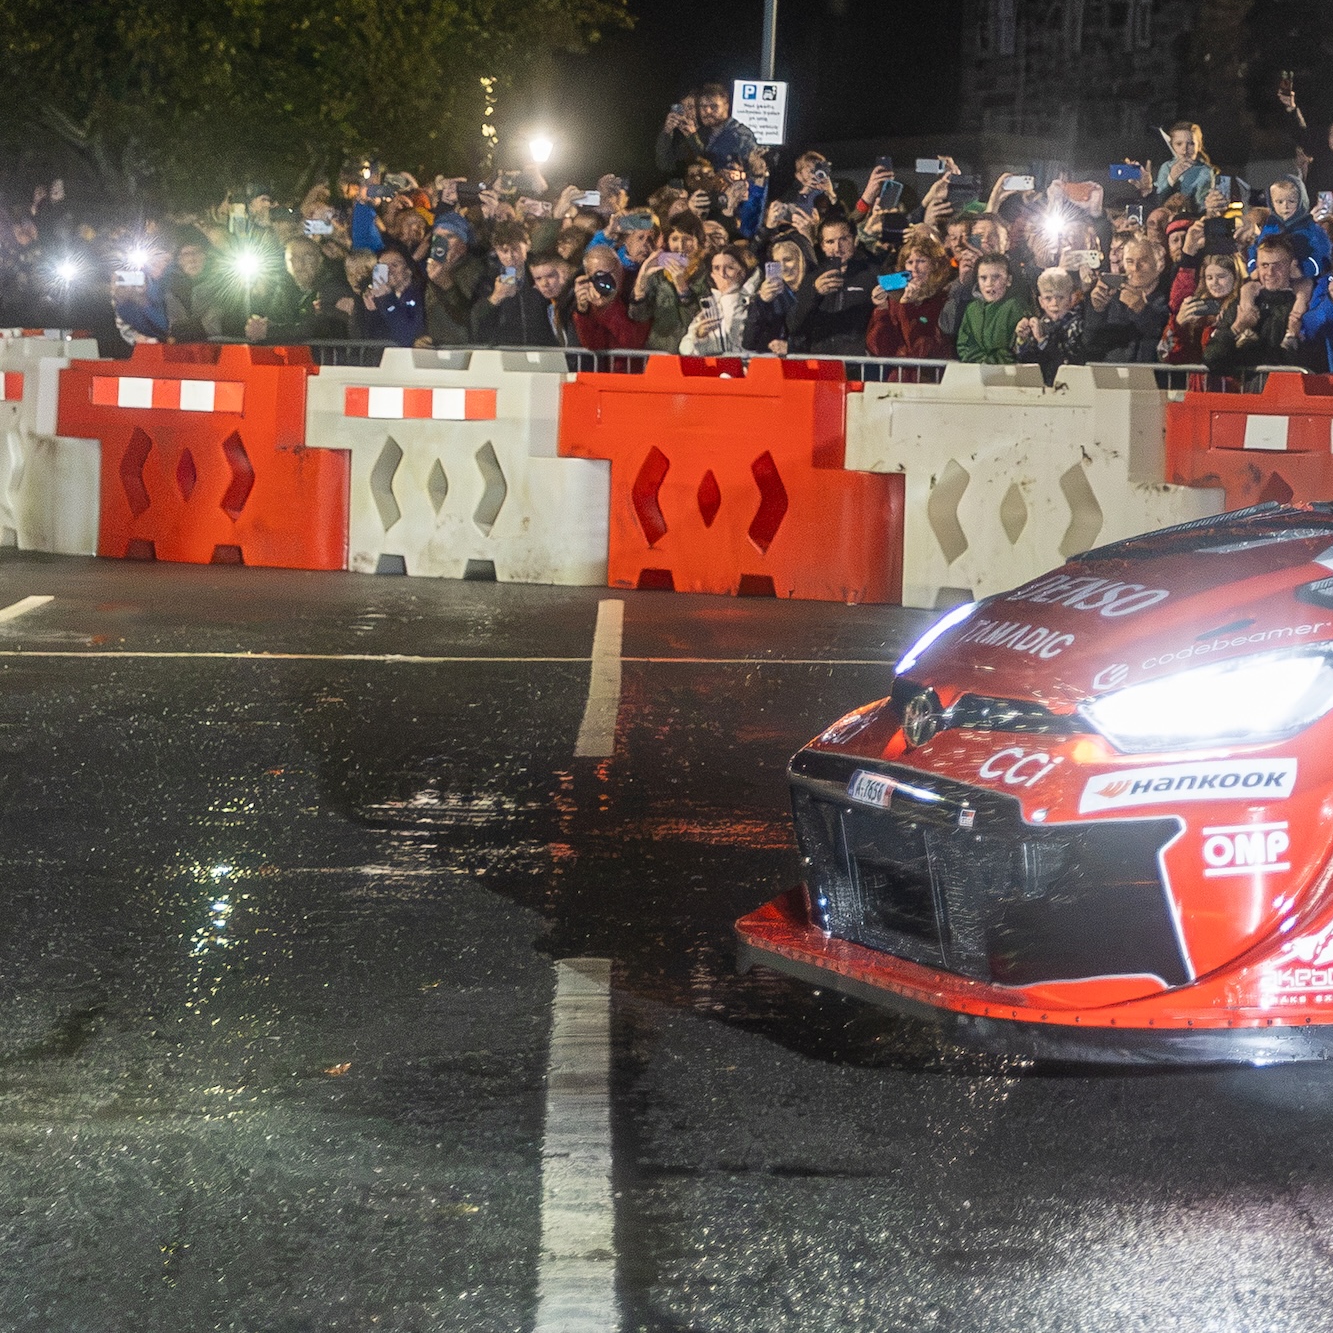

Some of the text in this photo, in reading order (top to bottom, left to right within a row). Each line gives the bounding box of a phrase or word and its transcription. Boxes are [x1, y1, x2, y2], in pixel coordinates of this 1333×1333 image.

[1006, 574, 1170, 616] DENSO
[956, 619, 1075, 659] TAMADIC
[1142, 622, 1325, 670] codebeamer
[1203, 830, 1290, 867] OMP
